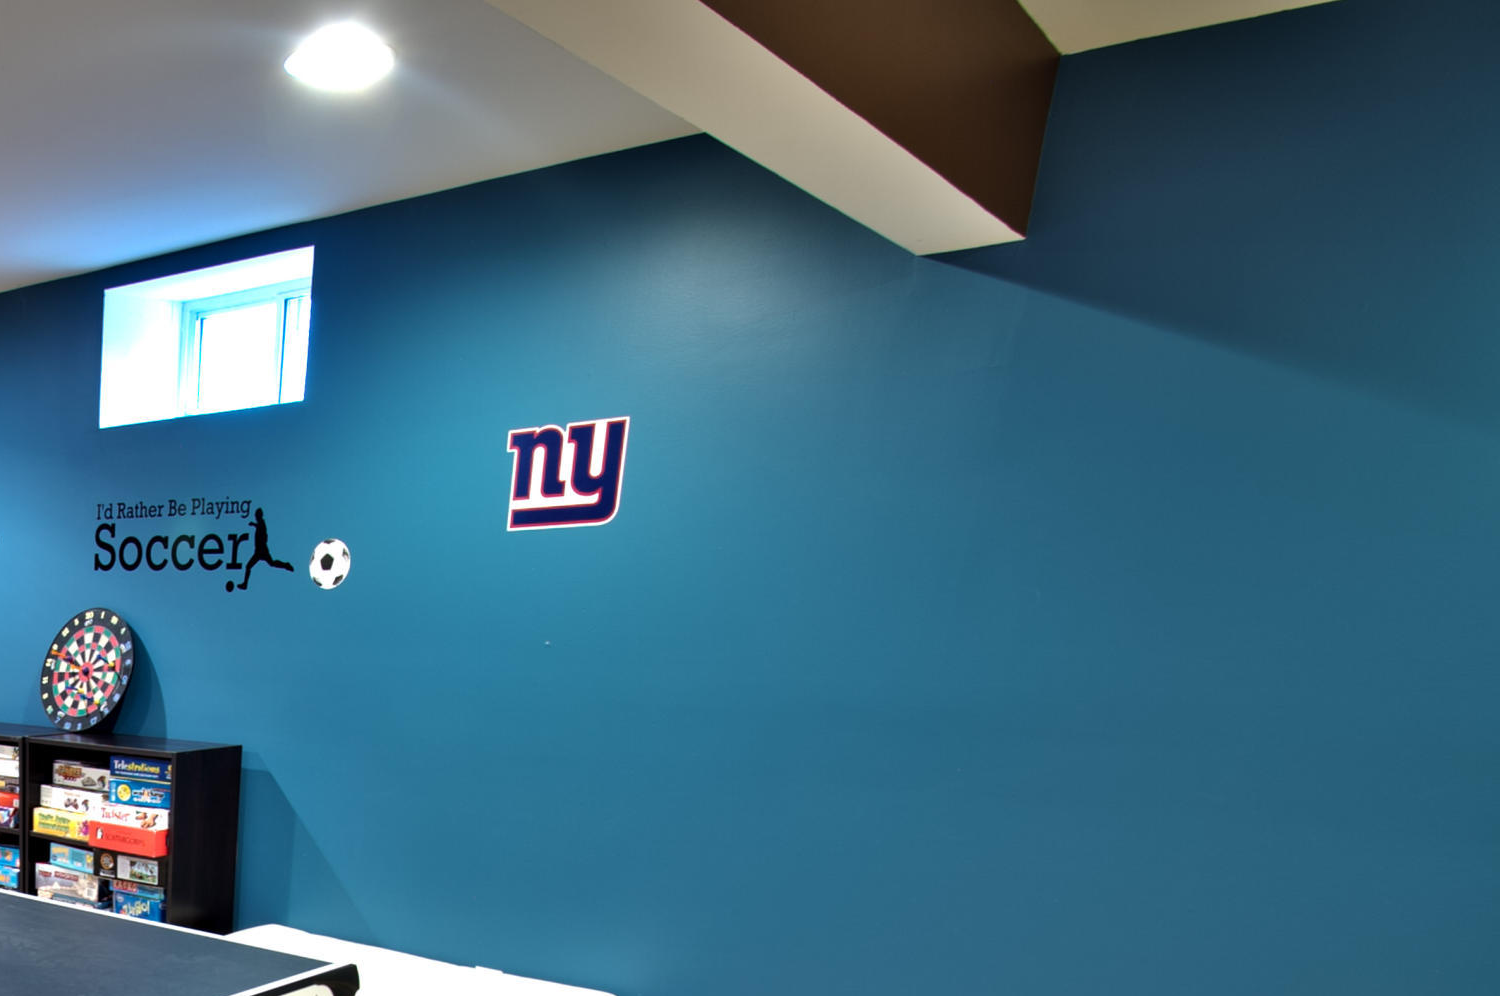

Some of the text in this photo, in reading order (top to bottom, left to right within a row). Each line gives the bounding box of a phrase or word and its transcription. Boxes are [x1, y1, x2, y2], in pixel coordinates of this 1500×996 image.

[97, 497, 252, 520] I'd Rather Be Playing
[94, 523, 249, 571] Soccer
